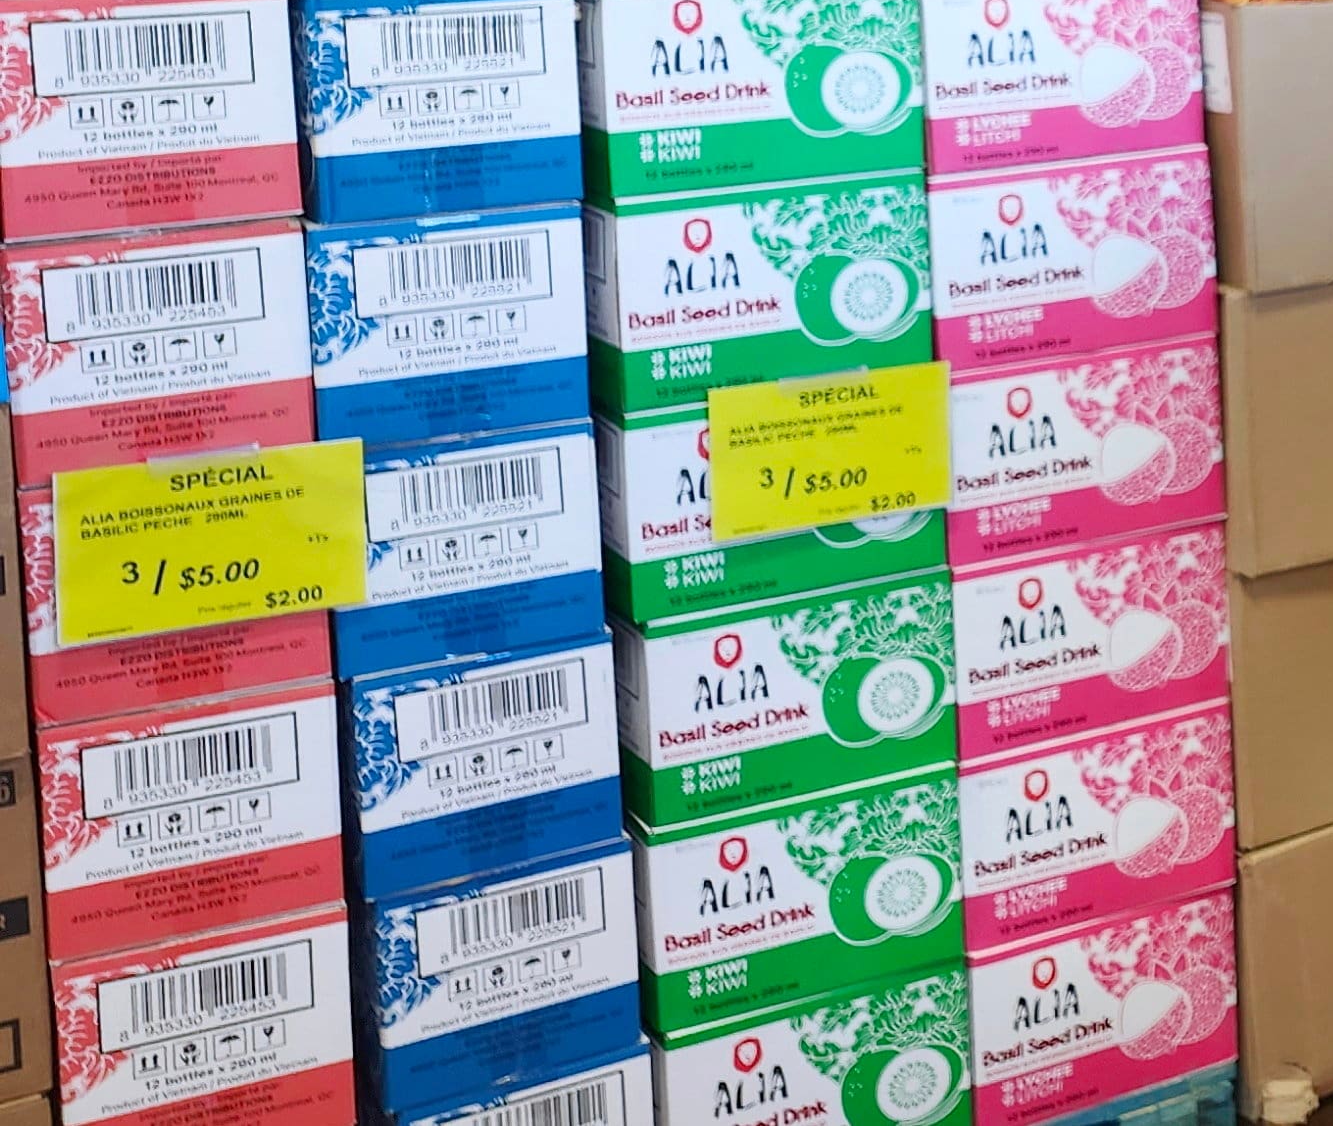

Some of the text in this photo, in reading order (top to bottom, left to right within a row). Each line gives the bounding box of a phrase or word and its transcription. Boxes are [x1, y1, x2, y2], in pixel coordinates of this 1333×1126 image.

[651, 34, 729, 77] ALIA
[967, 28, 1036, 69] ALIA
[615, 81, 771, 111] Basil Seed Drink
[983, 78, 1027, 95] Seed
[84, 132, 98, 143] 12
[103, 128, 153, 141] bottles
[657, 128, 701, 147] KIWI
[658, 145, 701, 164] KIWI
[664, 251, 742, 297] ALIA
[628, 296, 782, 332] Basil Seed Drink
[669, 343, 713, 362] KIWI
[670, 361, 713, 379] KIWI
[988, 415, 1057, 459] ALIA
[170, 464, 274, 493] SPÉCIAL
[759, 467, 774, 491] 3
[803, 467, 868, 494] $5.00
[1004, 465, 1048, 484] Seed
[80, 488, 305, 526] ALIA BOISSONAUX GRAINES DE
[870, 490, 916, 512] $2.00
[80, 524, 139, 541] BASILIC
[143, 516, 193, 531] PECHE
[641, 520, 691, 542] Basil
[682, 551, 726, 571] KIWI
[121, 558, 260, 595] 3 / $5.00
[683, 569, 725, 588] KIWI
[265, 585, 323, 610] $2.00
[694, 663, 770, 714] ALIA
[659, 703, 809, 749] Basil Seed Drink
[700, 755, 743, 776] KIWI
[700, 773, 742, 794] KIWI
[1006, 795, 1073, 843] ALIA
[1021, 846, 1064, 867] Seed
[699, 864, 776, 916] ALIA
[665, 901, 816, 953] Basil Seed Drink
[705, 958, 748, 980] KIWI
[706, 975, 748, 997] KIWI
[1014, 983, 1081, 1032] ALIA
[1028, 1033, 1072, 1055] Seed
[714, 1064, 789, 1119] ALIA
